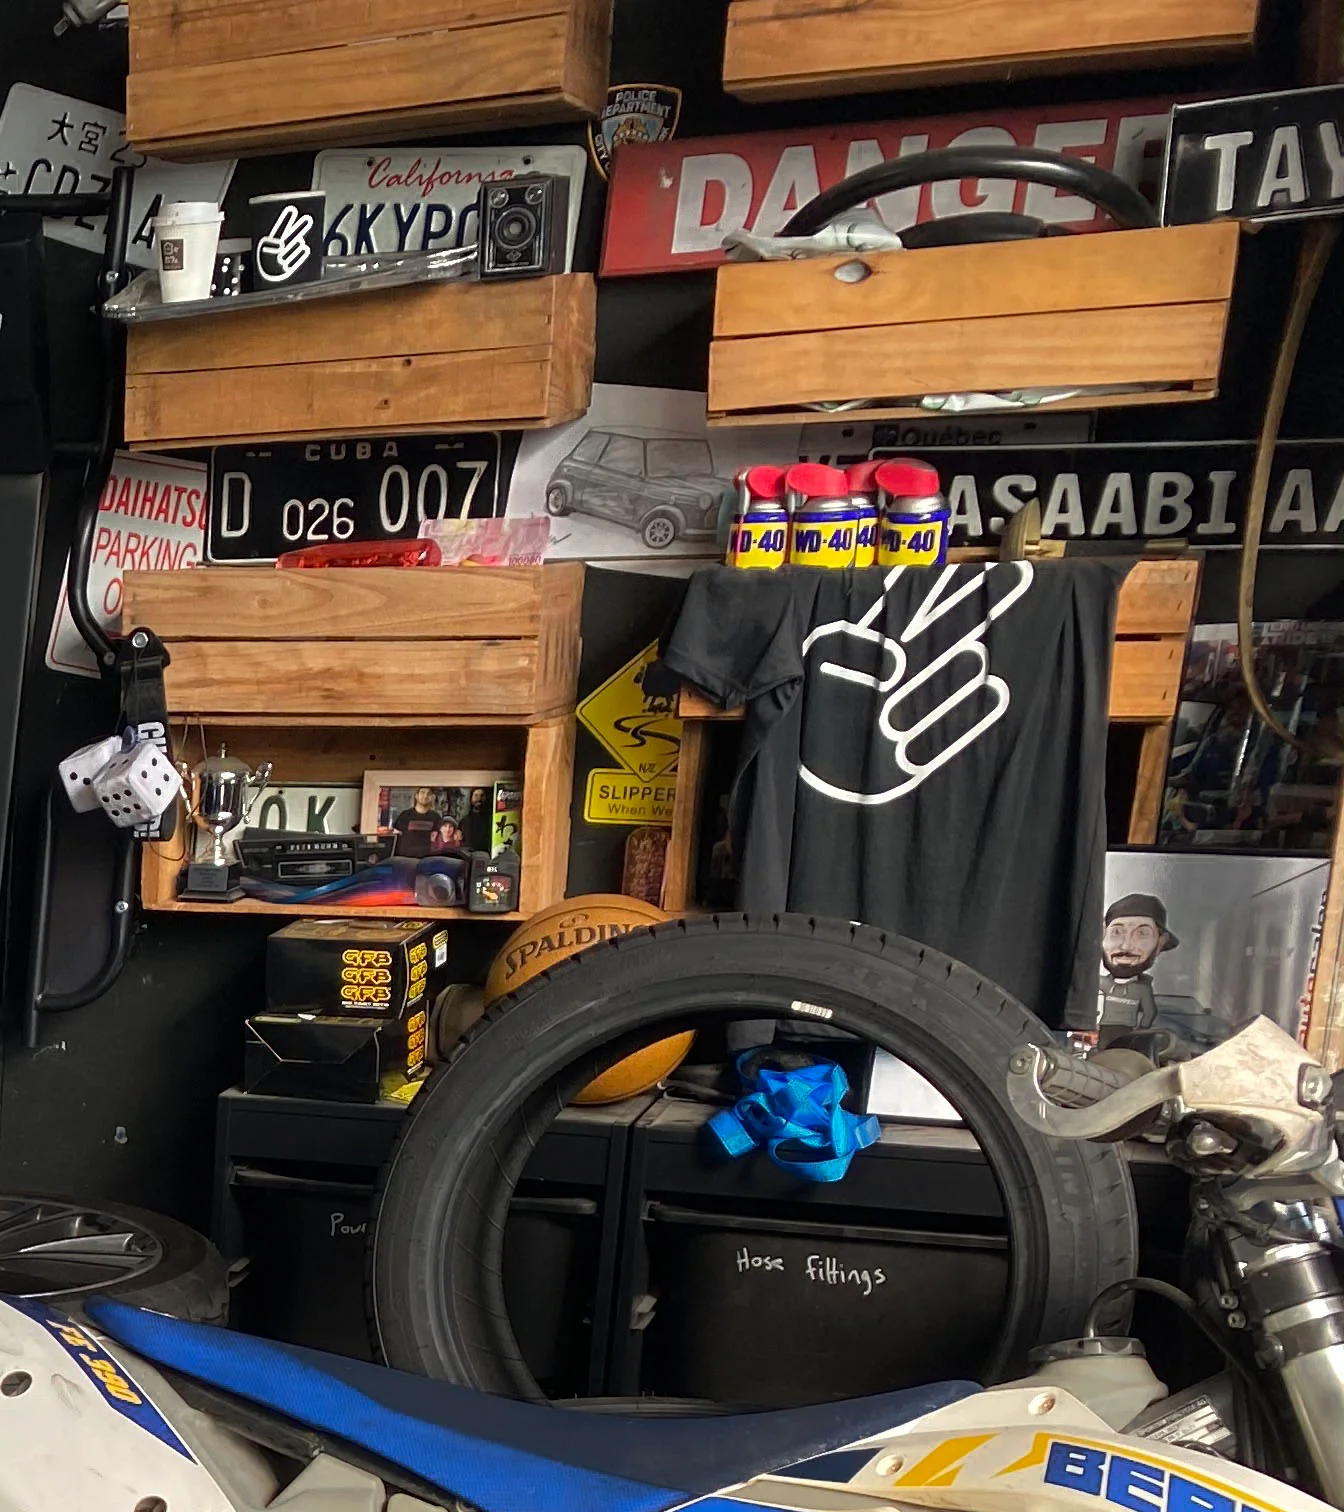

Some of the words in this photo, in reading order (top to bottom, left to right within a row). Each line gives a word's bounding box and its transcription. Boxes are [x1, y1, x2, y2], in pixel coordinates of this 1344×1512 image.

[616, 90, 657, 103] POLICE
[47, 112, 108, 155] 大宮
[366, 156, 515, 198] California
[901, 425, 1002, 446] Québec
[305, 442, 399, 462] CUBA
[220, 472, 252, 539] D
[282, 498, 355, 542] 026
[379, 461, 489, 534] 007
[93, 527, 198, 570] PARKING
[796, 528, 853, 553] WD-40
[608, 802, 647, 817] When
[341, 949, 393, 967] GFB
[340, 966, 392, 985] GFB
[340, 984, 392, 1002] GFB
[736, 1247, 785, 1273] Hose
